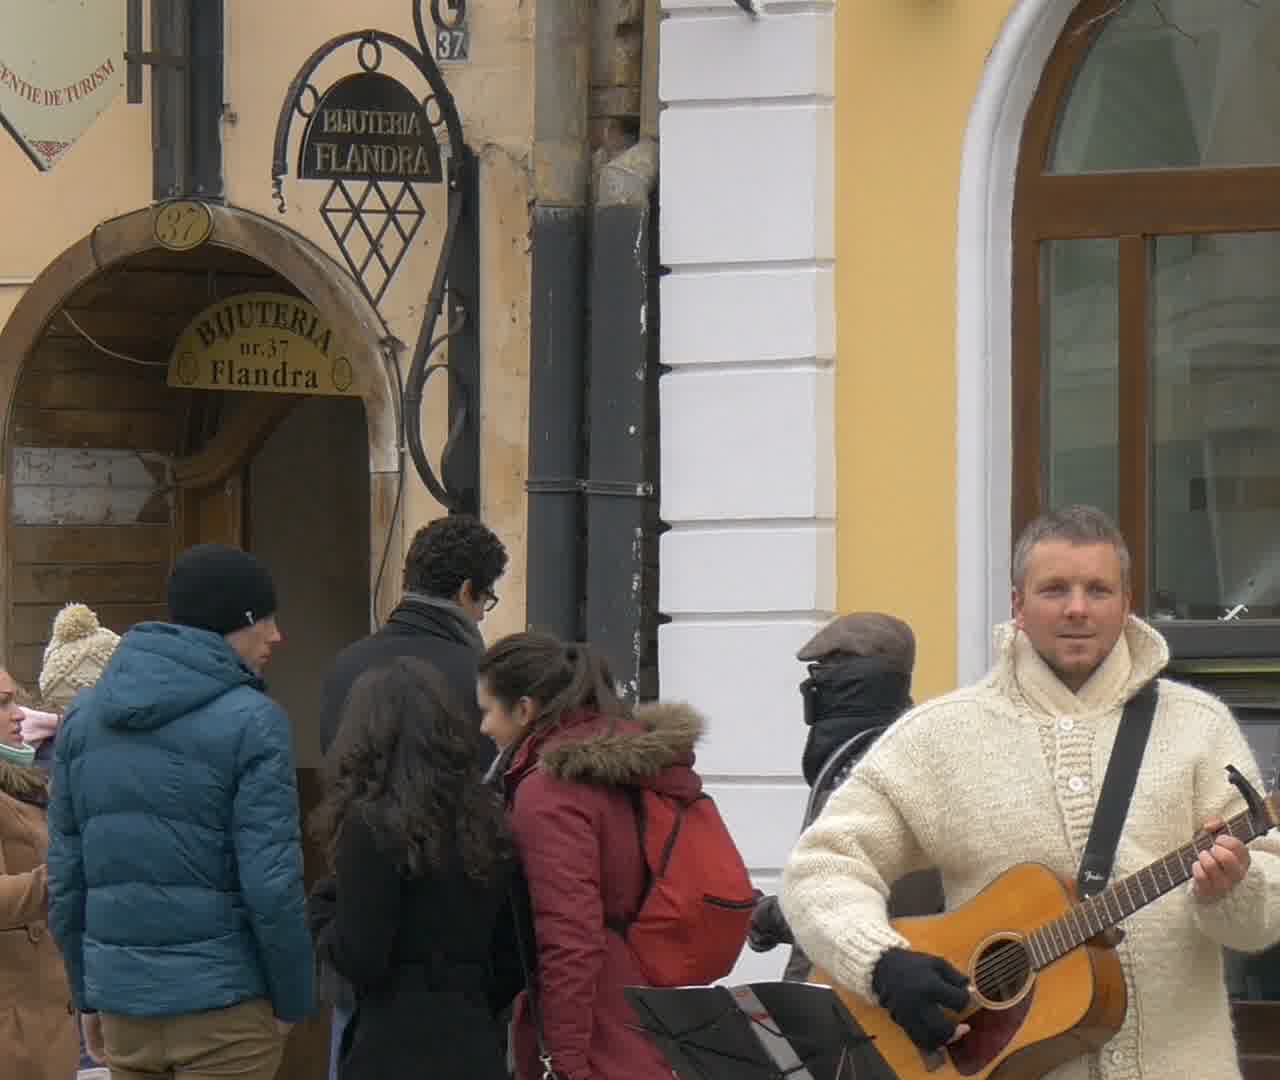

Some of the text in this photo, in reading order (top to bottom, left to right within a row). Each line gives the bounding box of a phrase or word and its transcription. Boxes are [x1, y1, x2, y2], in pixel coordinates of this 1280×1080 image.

[438, 31, 465, 58] 37
[43, 87, 65, 106] DE
[63, 57, 116, 102] TURISM
[322, 109, 422, 135] BIJUTERIA
[315, 143, 432, 176] FLANDRA
[161, 207, 200, 241] 37
[195, 301, 332, 358] BIJUTERIA
[210, 360, 319, 389] Flandra
